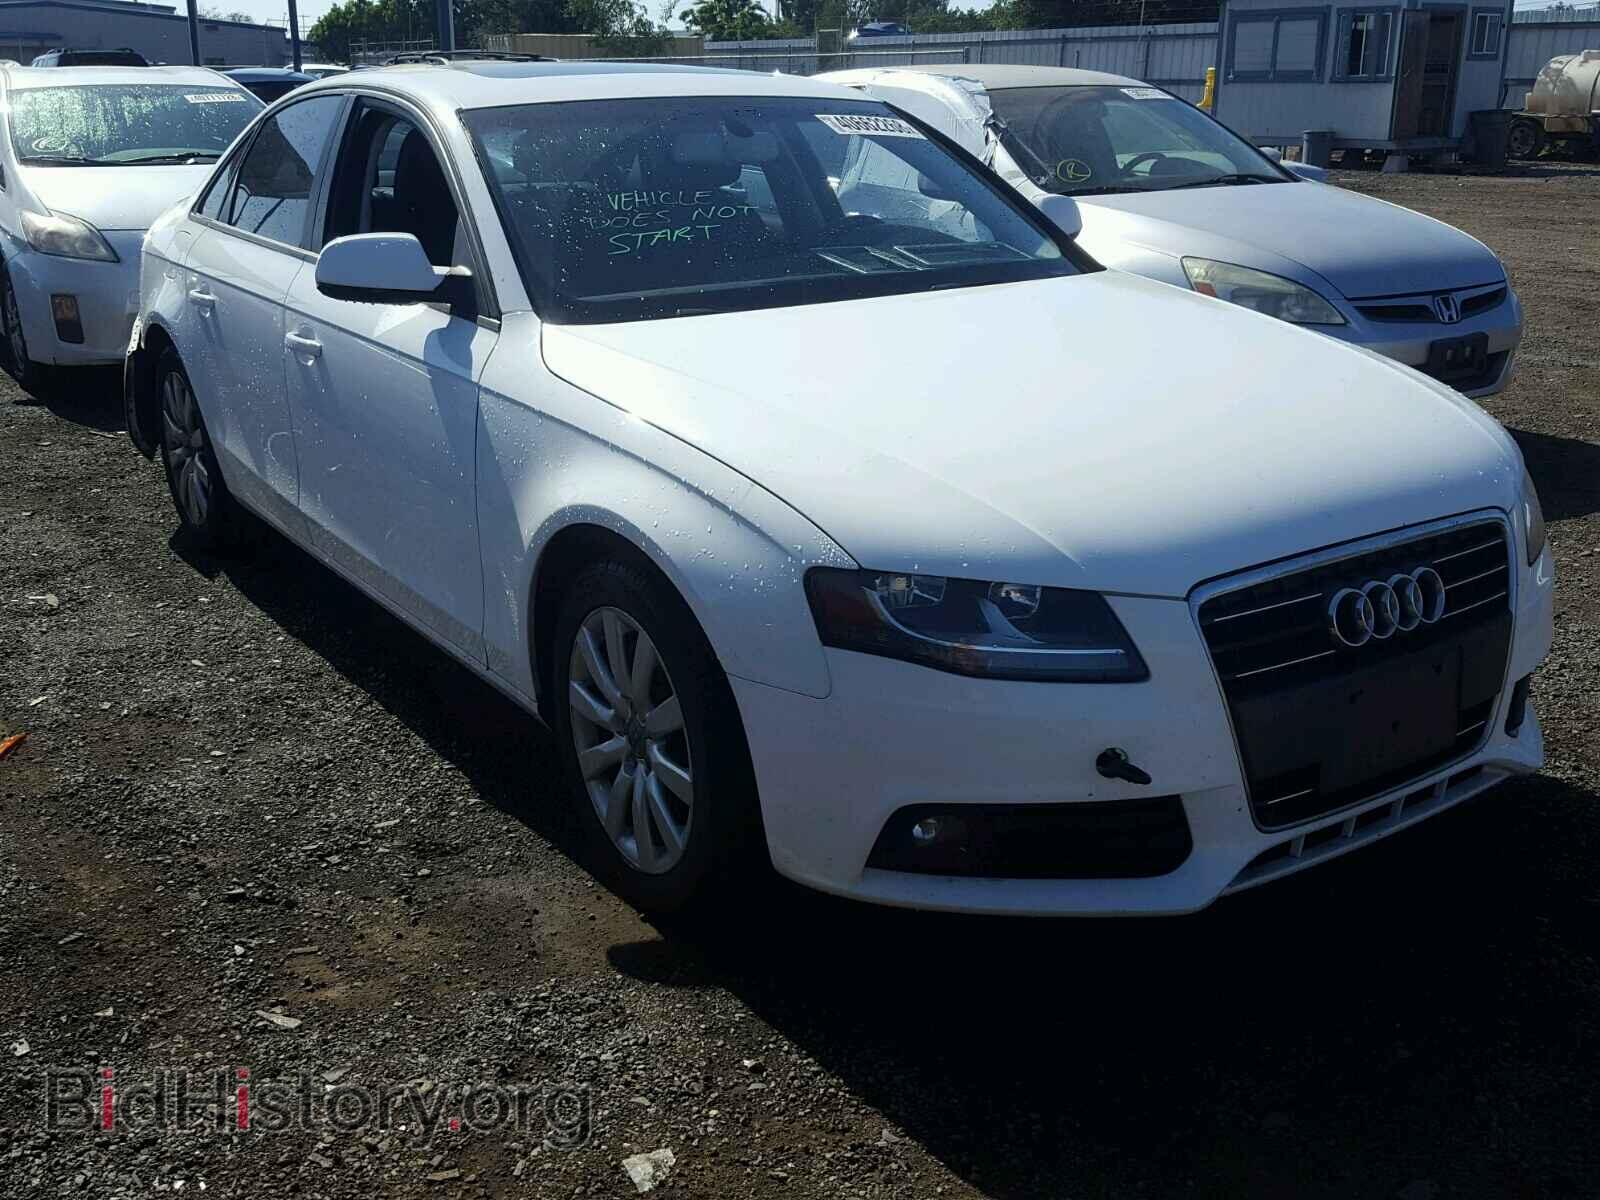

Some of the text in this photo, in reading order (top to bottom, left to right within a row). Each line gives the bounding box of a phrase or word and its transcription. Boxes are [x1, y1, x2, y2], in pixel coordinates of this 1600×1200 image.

[607, 191, 713, 211] VEHICLE
[583, 205, 758, 230] DOES NOT
[607, 224, 721, 255] START
